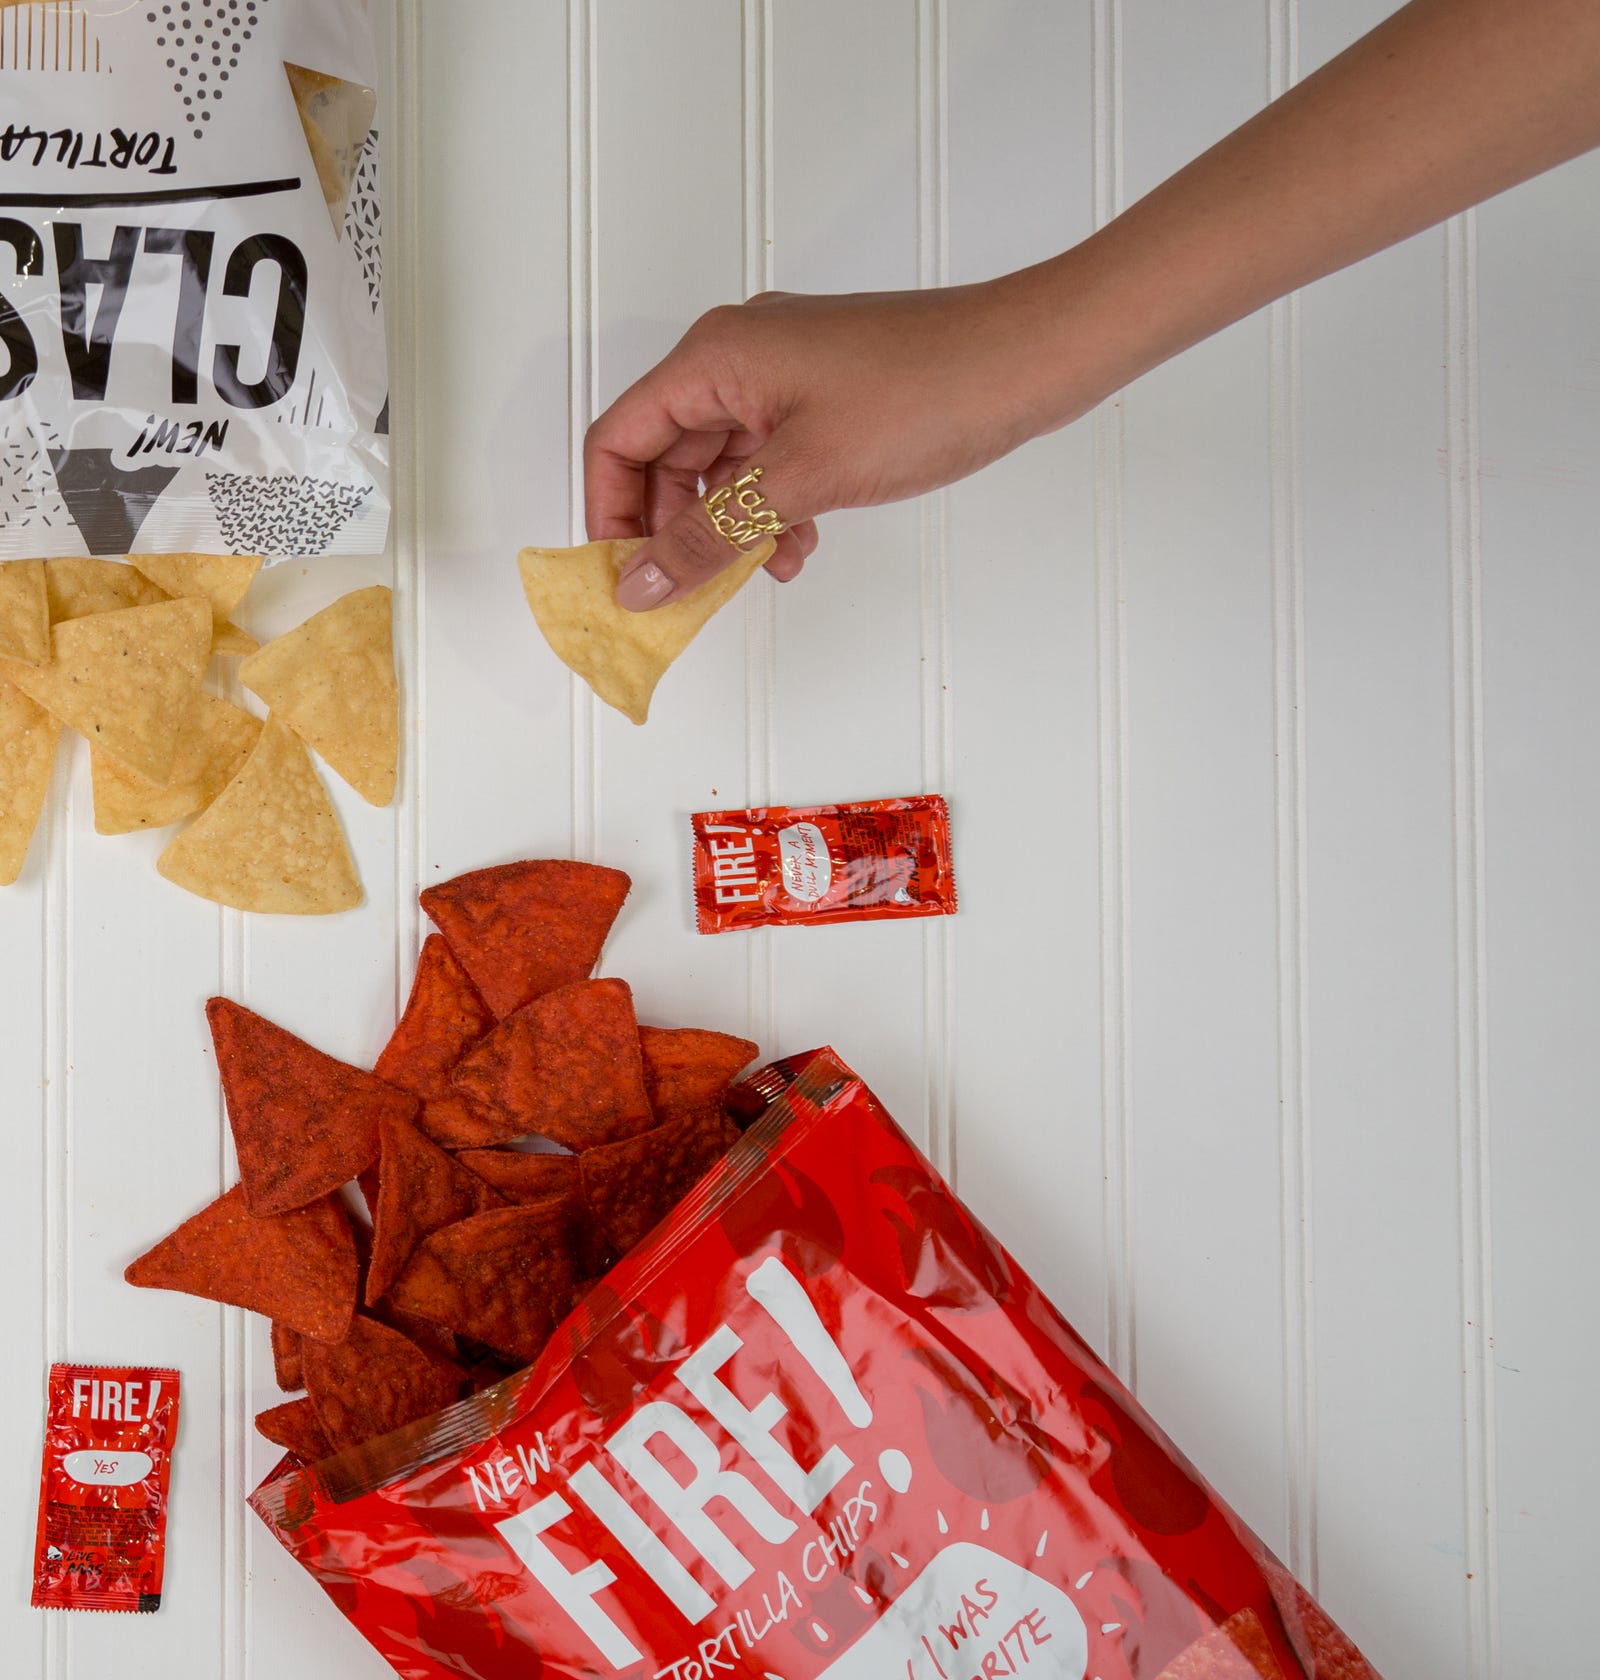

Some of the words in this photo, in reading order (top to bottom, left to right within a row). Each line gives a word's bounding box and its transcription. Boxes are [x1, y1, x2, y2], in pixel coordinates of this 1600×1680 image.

[0, 127, 178, 175] TORTILLA
[130, 413, 229, 458] NEW!
[704, 824, 763, 904] FIRE!
[788, 840, 801, 849] A
[797, 825, 818, 869] MOMENT
[790, 855, 804, 892] NEVER
[806, 871, 820, 898] DULL
[71, 1379, 162, 1433] FIRE!
[467, 1431, 552, 1511] NEW
[494, 1256, 912, 1671] FIRE!
[802, 1481, 878, 1583] CHIPS
[938, 1578, 998, 1650] WAS
